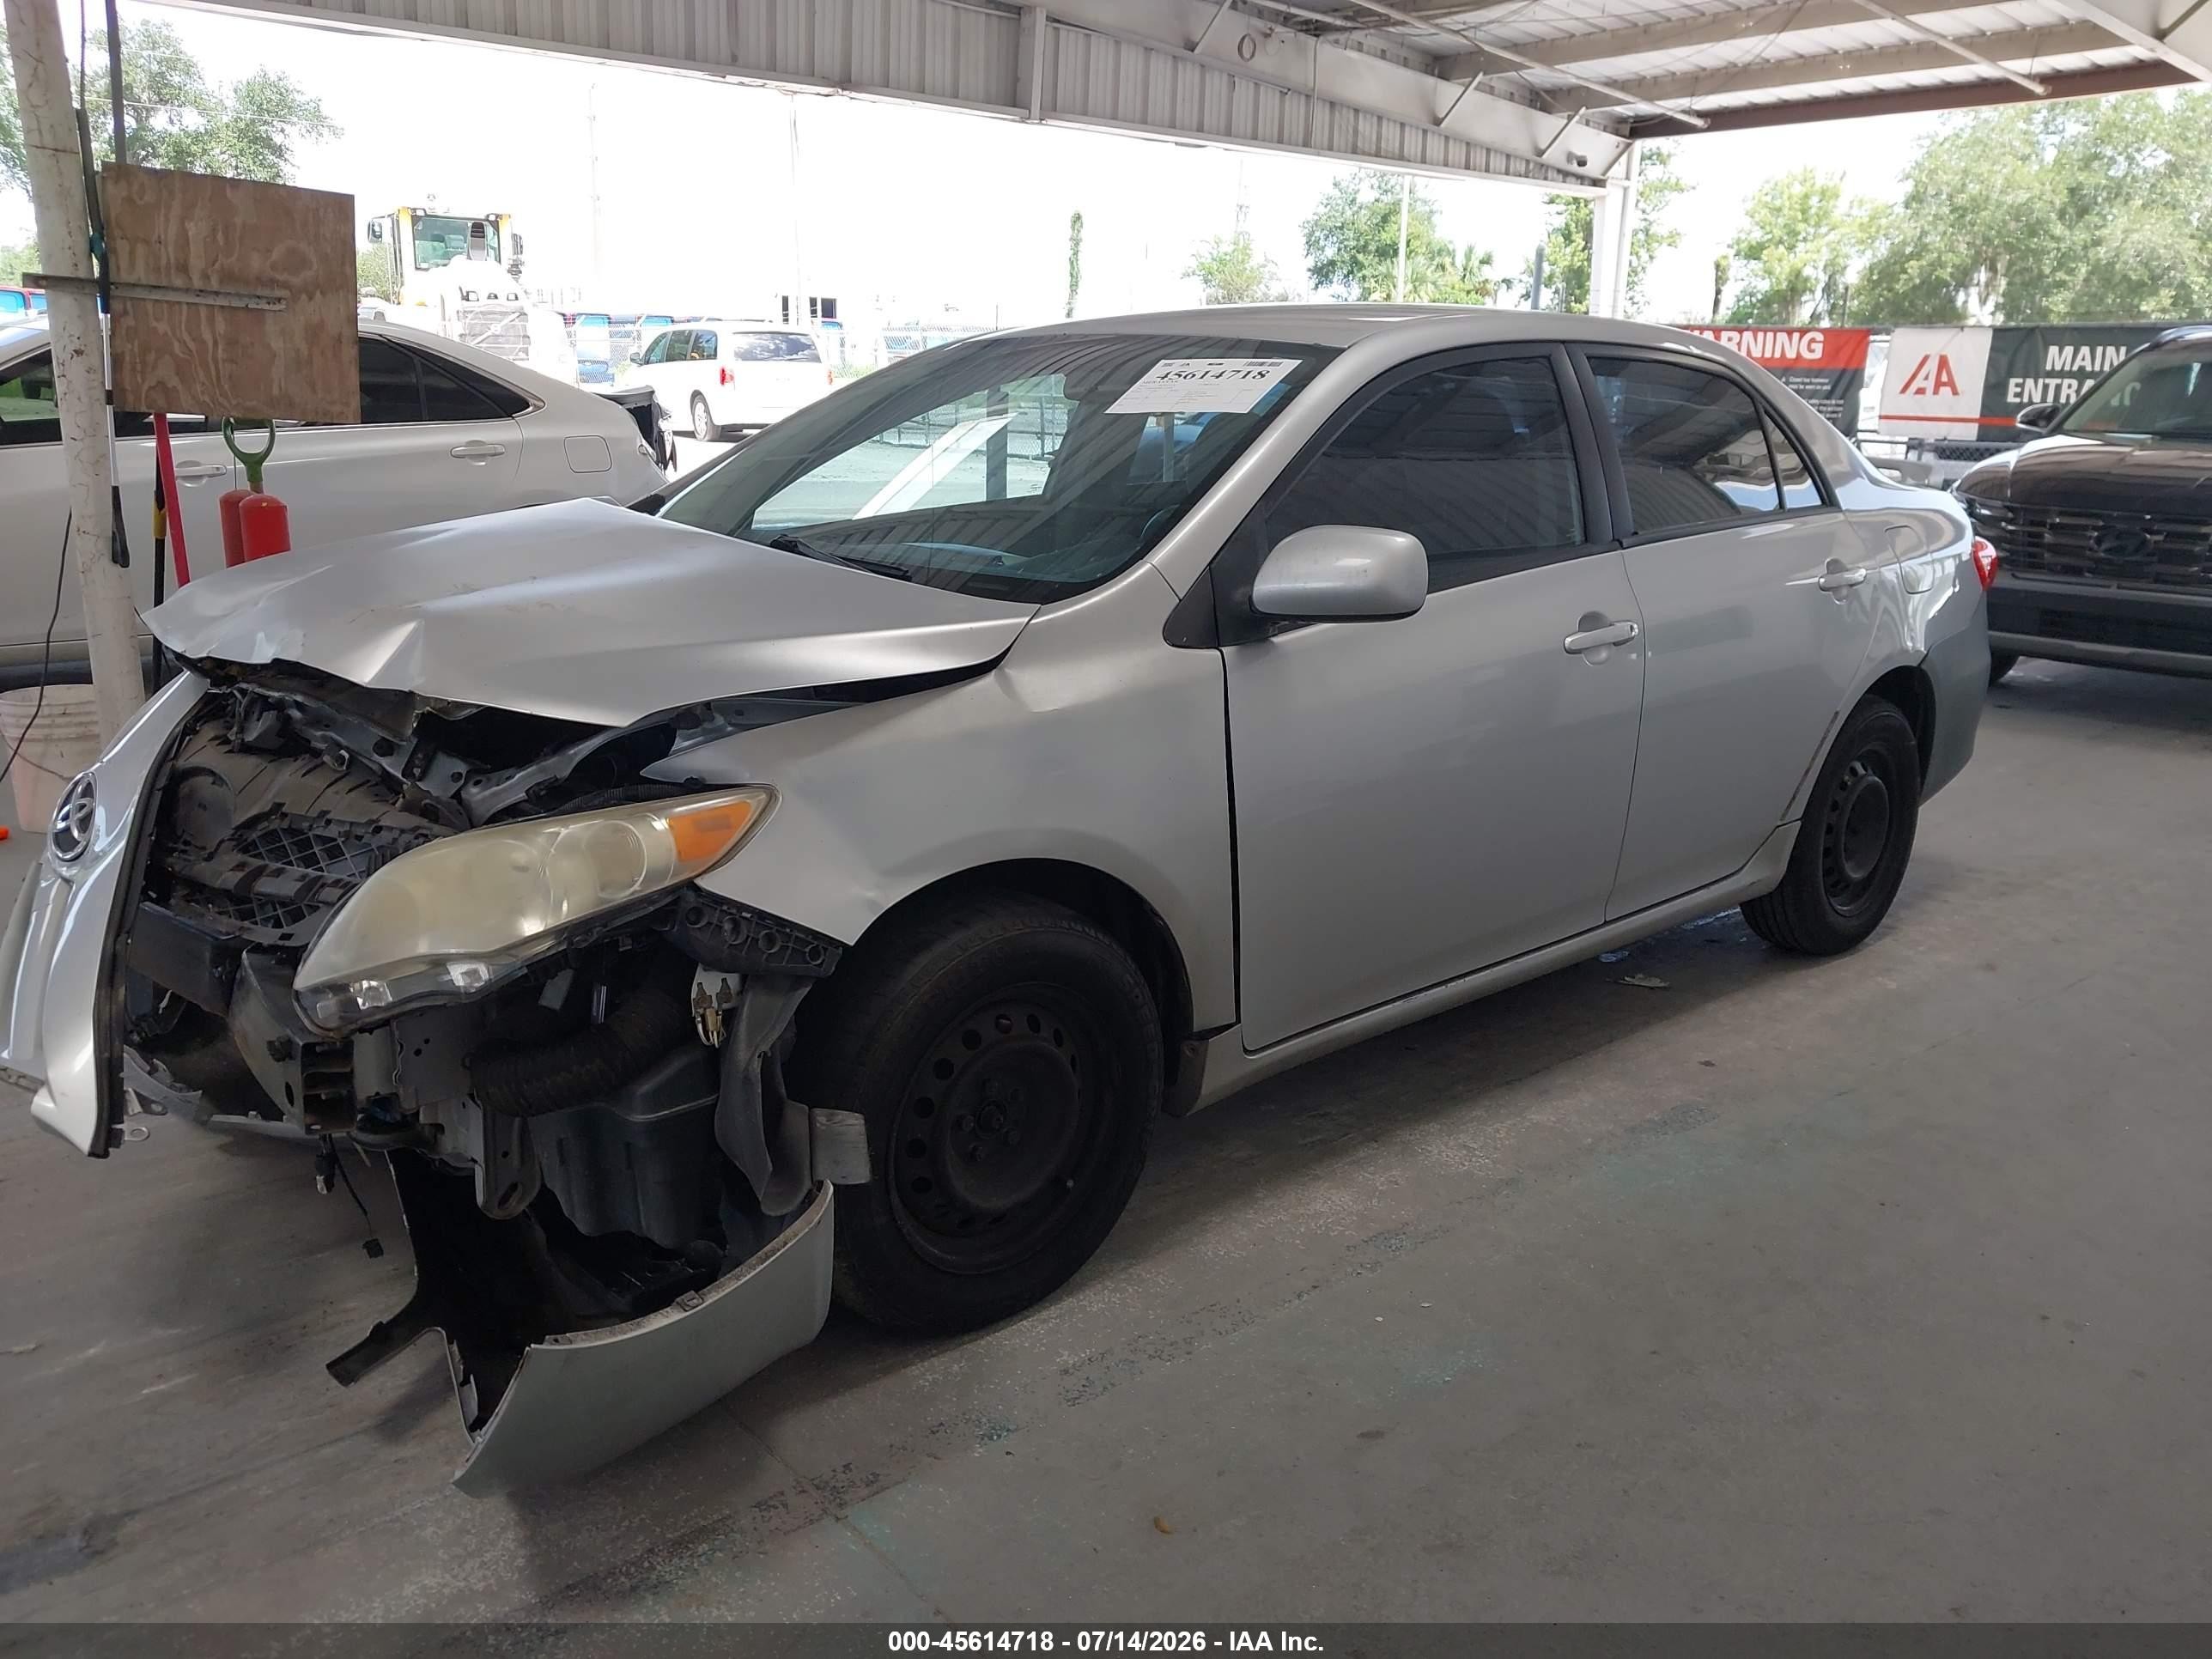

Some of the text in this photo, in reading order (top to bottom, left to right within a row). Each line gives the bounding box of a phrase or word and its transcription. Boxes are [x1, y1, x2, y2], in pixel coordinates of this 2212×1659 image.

[1690, 331, 1825, 360] RNING
[2045, 345, 2128, 372] MAIN
[1156, 369, 1271, 380] 45614718
